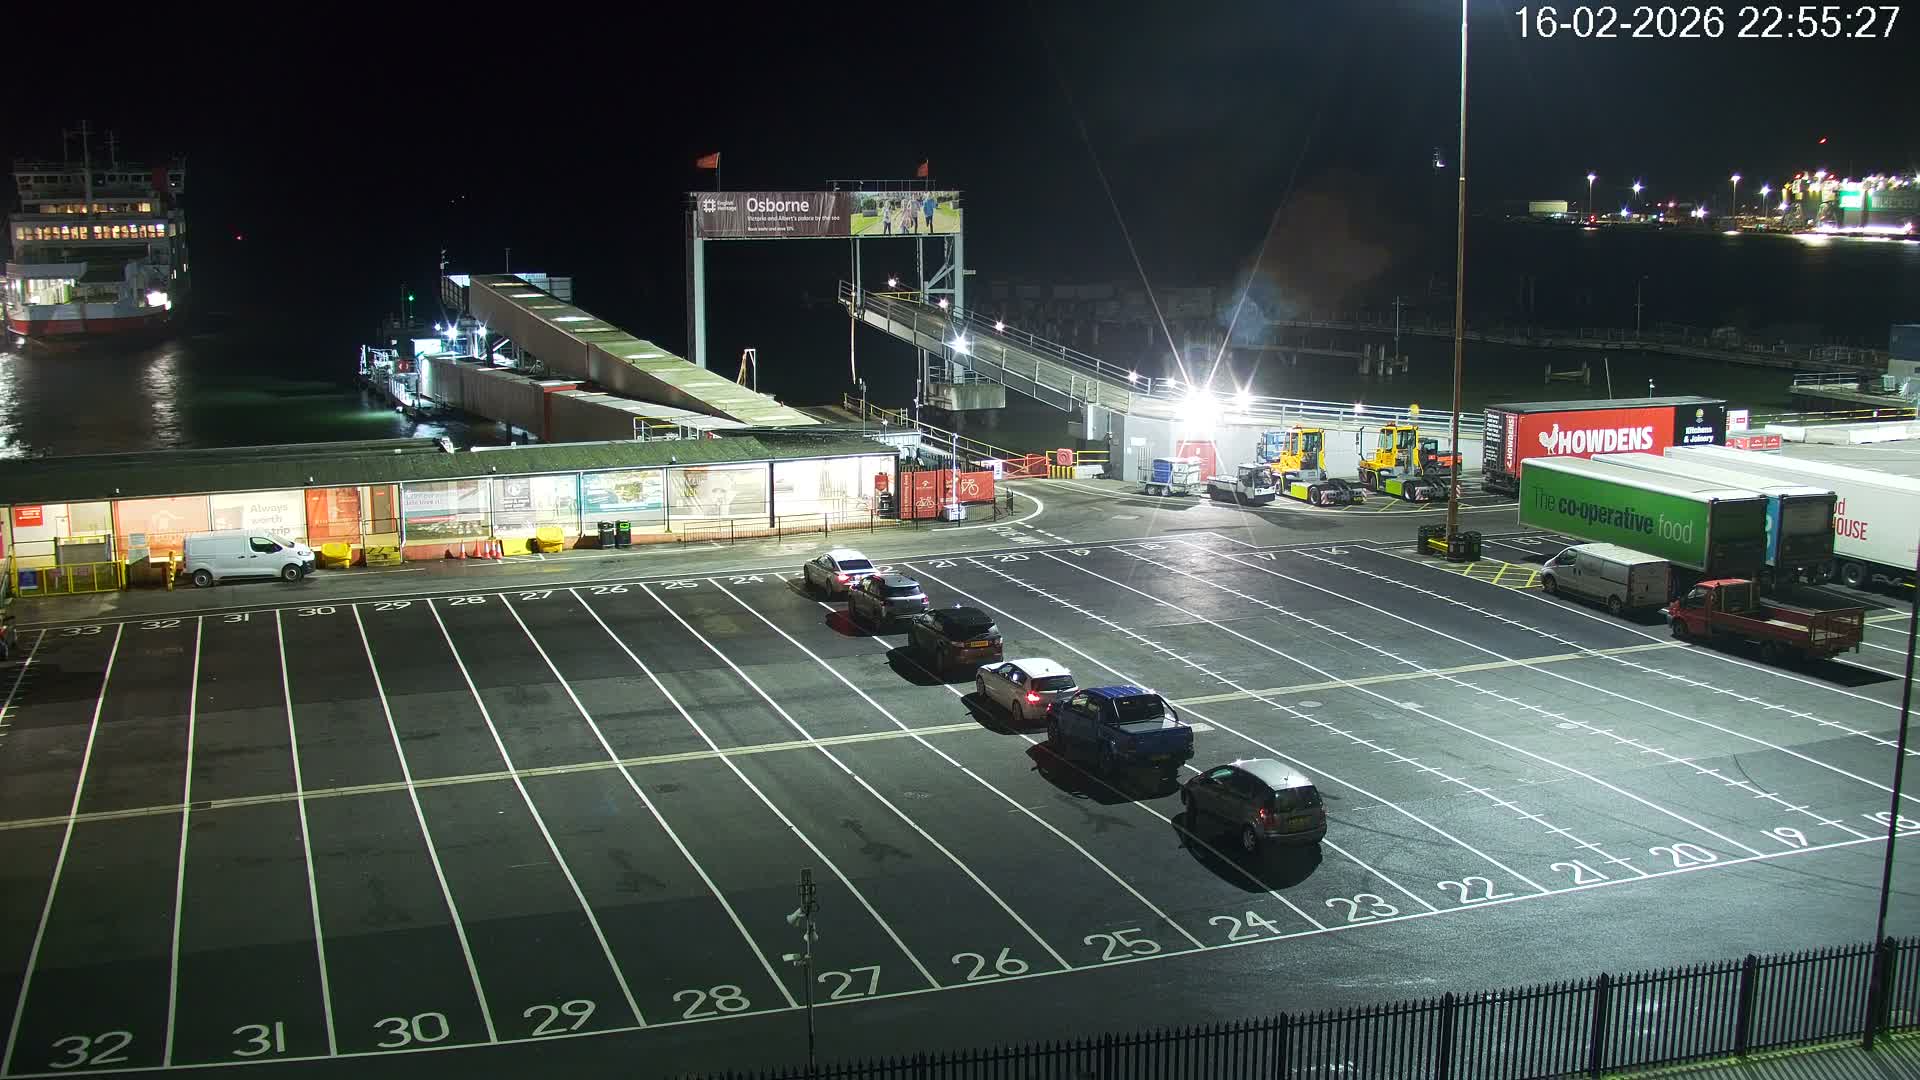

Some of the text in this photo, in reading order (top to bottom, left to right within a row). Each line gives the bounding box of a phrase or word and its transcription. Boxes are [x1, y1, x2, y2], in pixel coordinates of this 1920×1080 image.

[746, 198, 809, 213] Osborne
[1557, 426, 1653, 454] HOWDENS
[1685, 426, 1713, 436] Kitchens
[1690, 435, 1714, 443] Joinery
[250, 503, 289, 515] Always
[1532, 484, 1556, 513] The
[1658, 512, 1693, 545] food
[928, 558, 958, 569] 21
[993, 552, 1030, 563] 20
[660, 579, 699, 590] 25
[729, 574, 765, 585] 24
[519, 589, 553, 601] 27
[590, 584, 629, 595] 26
[373, 600, 412, 612] 29
[448, 595, 487, 606] 28
[223, 613, 250, 623] 31
[297, 605, 337, 617] 30
[60, 625, 103, 637] 33
[139, 619, 182, 630] 32
[1759, 826, 1809, 849] 19
[1648, 842, 1718, 868] 20
[1550, 859, 1610, 886] 21
[1436, 875, 1515, 905] 22
[1325, 892, 1400, 923] 23
[1208, 910, 1282, 942] 24
[1083, 927, 1162, 962] 25
[950, 946, 1030, 982] 26
[817, 964, 882, 1001] 27
[672, 984, 752, 1020] 28
[522, 999, 597, 1037] 29
[231, 1020, 287, 1057] 31
[372, 1012, 451, 1049] 30
[47, 1030, 135, 1069] 32
